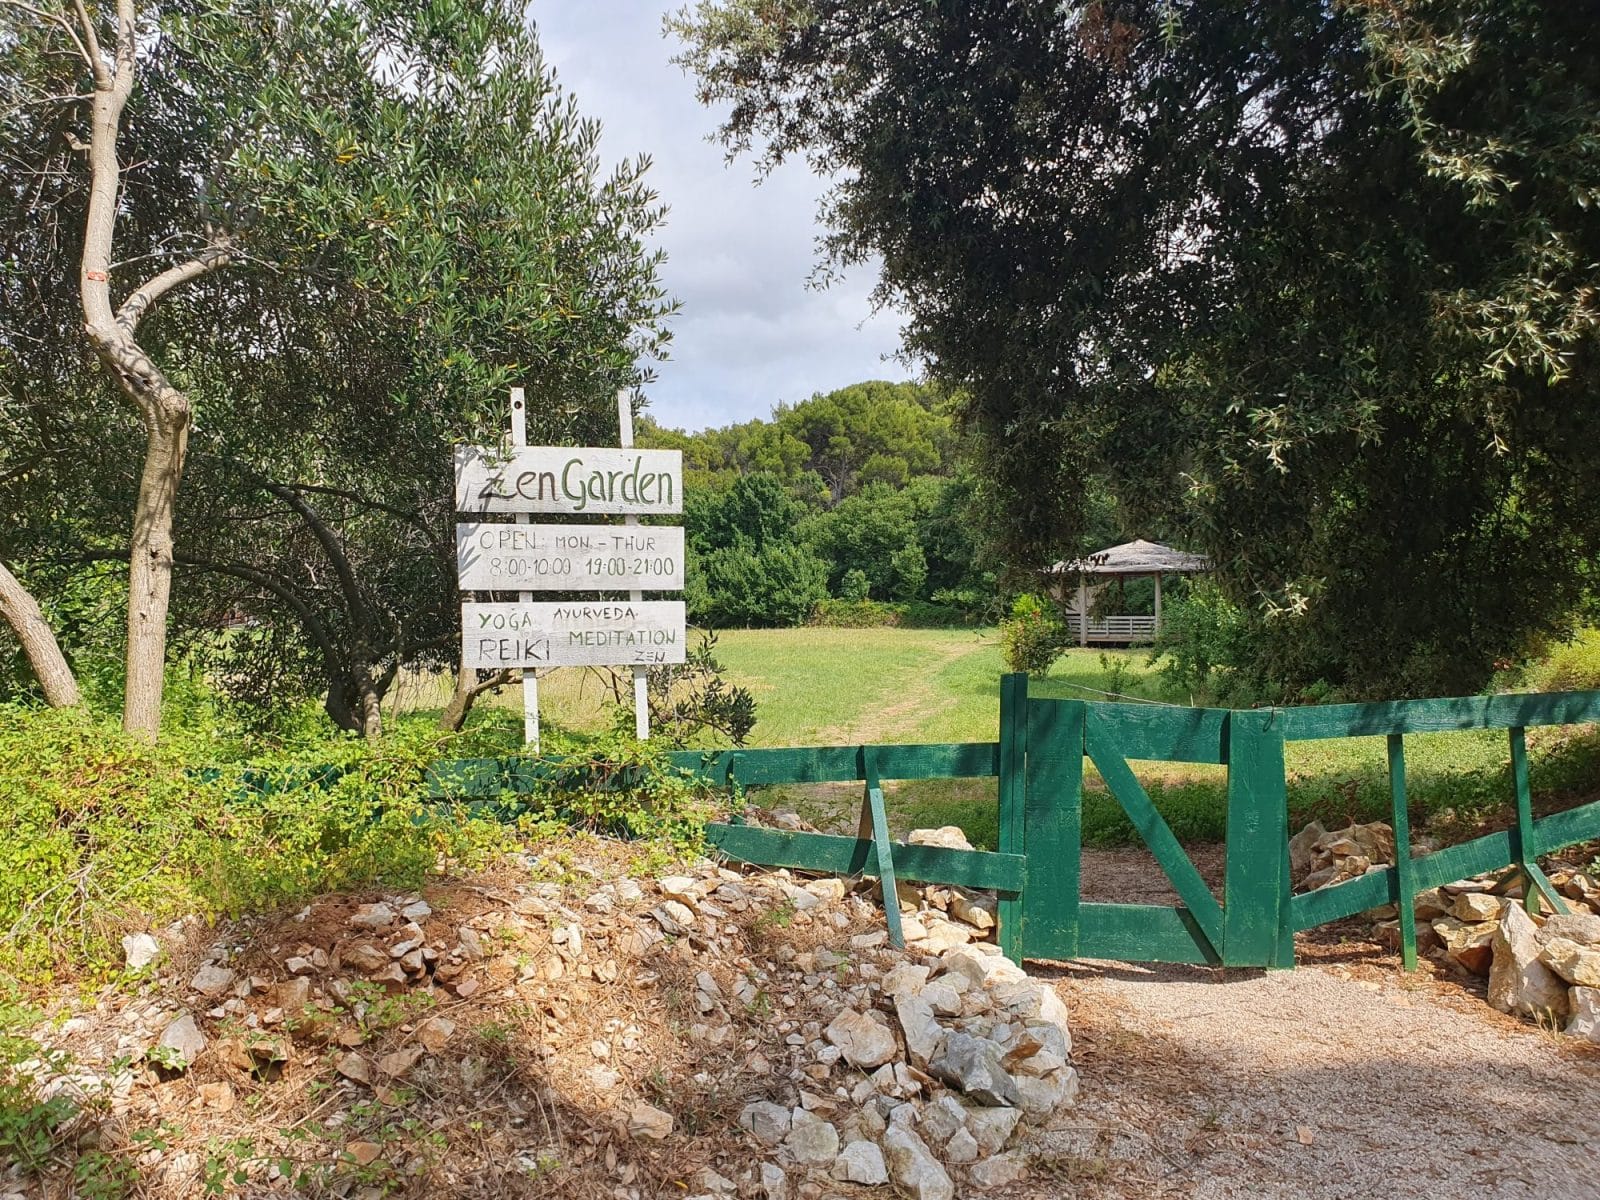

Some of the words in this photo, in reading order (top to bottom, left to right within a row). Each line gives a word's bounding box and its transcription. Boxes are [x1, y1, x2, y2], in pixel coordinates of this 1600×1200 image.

[561, 456, 673, 510] Garden
[612, 535, 656, 551] THUR
[585, 557, 674, 576] 19:00-21:00
[478, 611, 532, 631] YOGA
[569, 630, 676, 646] MEDITATION
[479, 638, 550, 661] REIKI
[634, 650, 666, 663] ZEN
